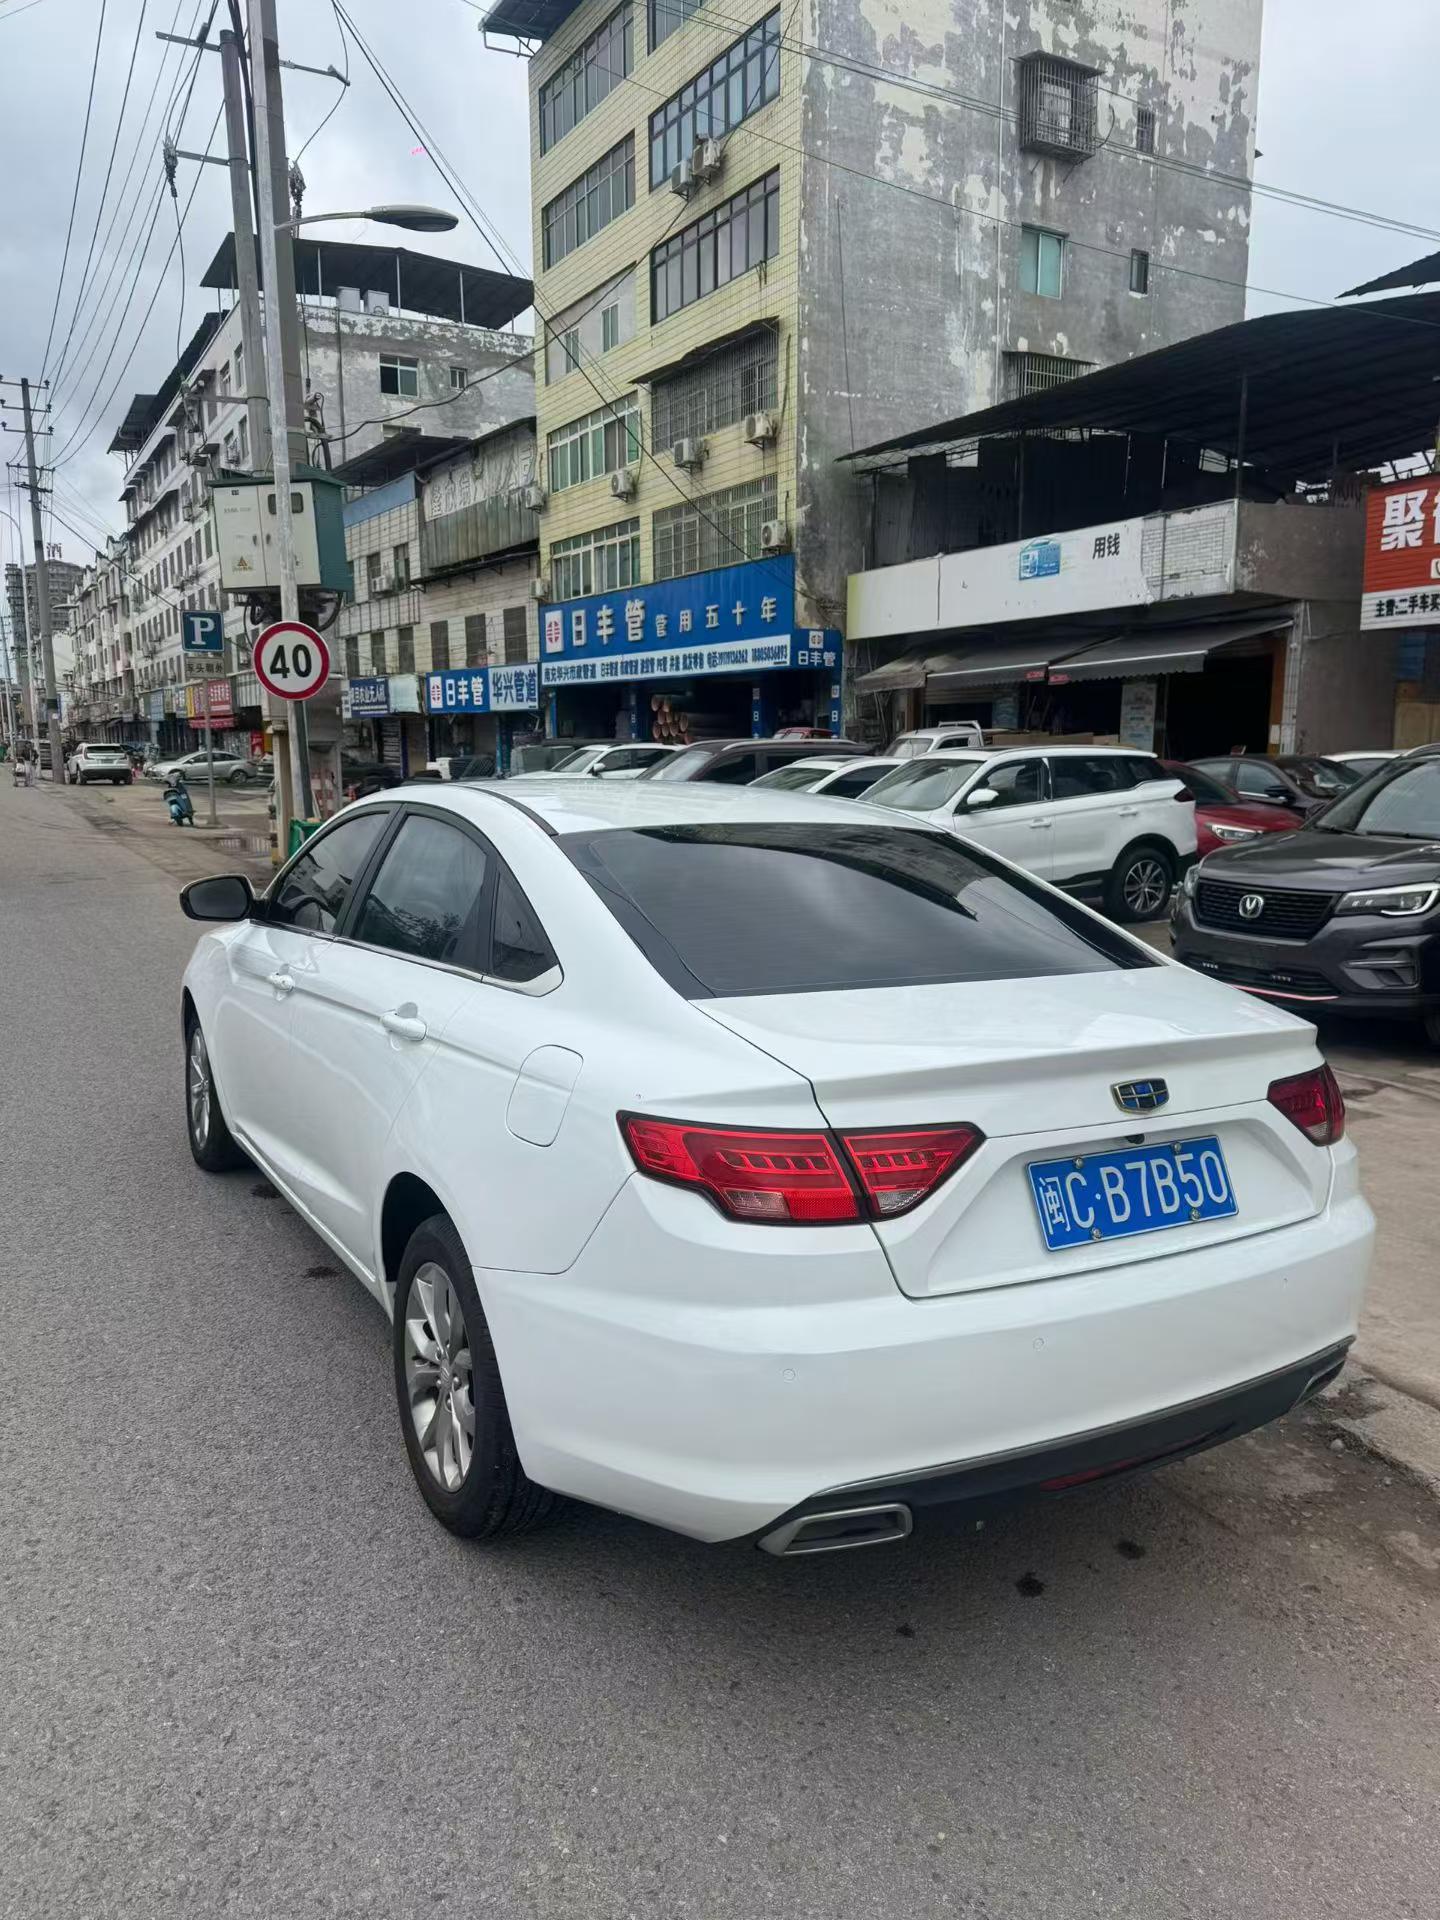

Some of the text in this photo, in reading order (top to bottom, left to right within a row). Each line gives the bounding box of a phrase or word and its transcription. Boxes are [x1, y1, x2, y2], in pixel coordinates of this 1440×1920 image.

[1092, 532, 1120, 560] 用钱
[190, 617, 215, 645] P
[572, 599, 646, 646] 日丰管
[270, 644, 312, 678] 40
[798, 650, 836, 667] 日丰管
[446, 676, 483, 706] 日丰管
[492, 668, 537, 704] 华兴管道
